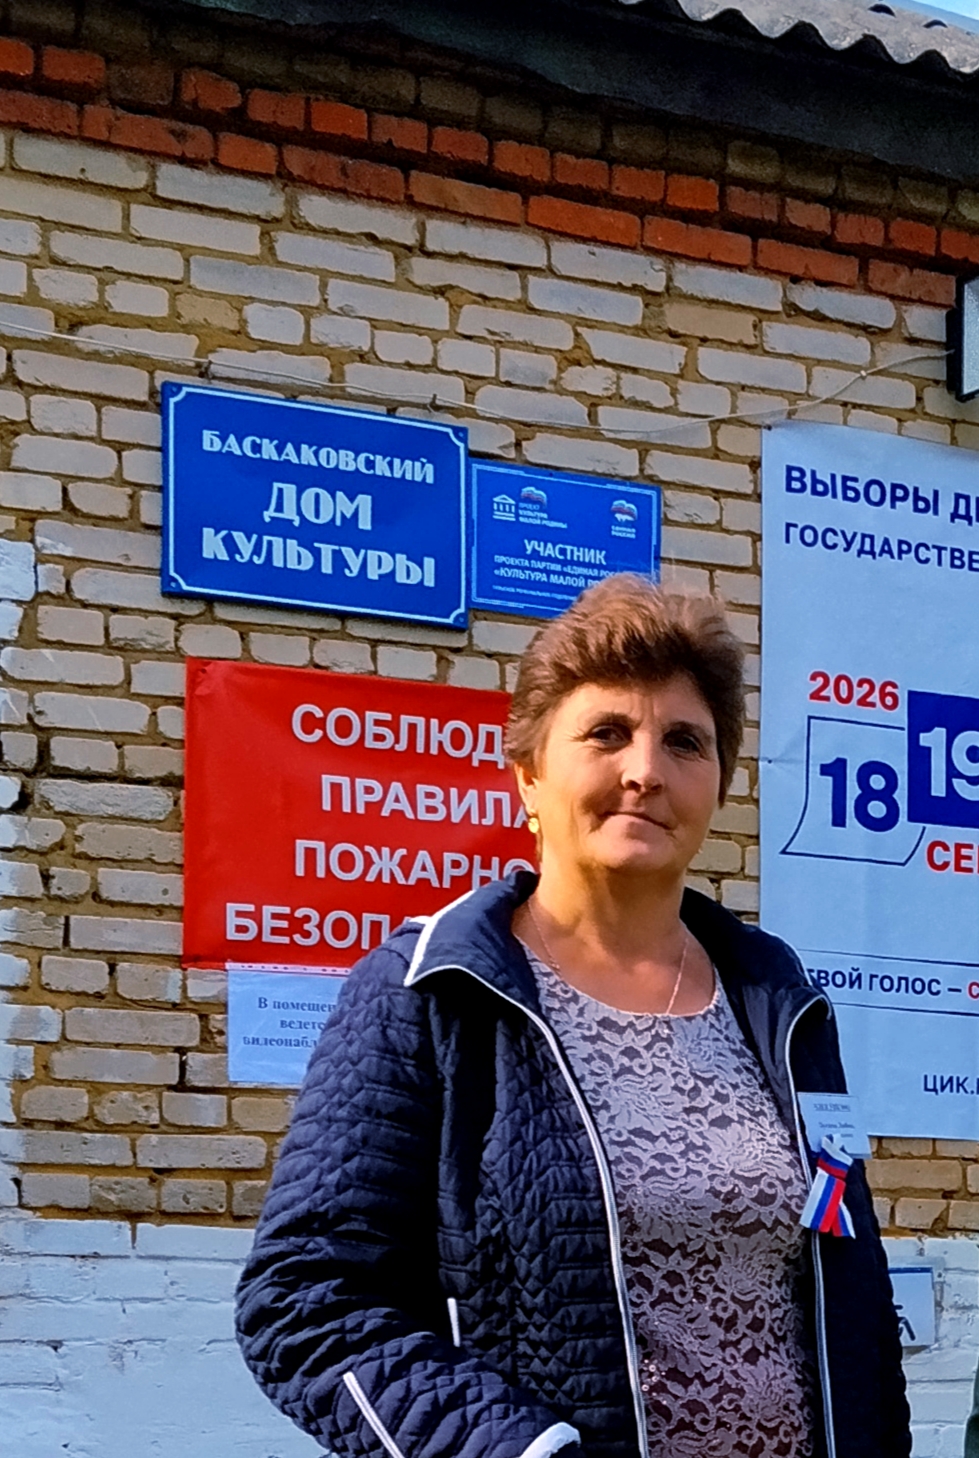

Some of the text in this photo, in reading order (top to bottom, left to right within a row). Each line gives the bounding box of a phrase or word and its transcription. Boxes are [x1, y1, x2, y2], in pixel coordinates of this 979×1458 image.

[202, 429, 434, 484] БАСКАКОВСКИЙ
[263, 481, 372, 530] ДОМ
[785, 464, 940, 516] ВЫБОРЫ
[202, 527, 435, 587] КУЛЬТУРЫ
[494, 555, 529, 567] ПРОЕКТА
[524, 539, 607, 565] УЧАСТНИК
[494, 567, 548, 582] «КУЛЬТУРА
[550, 573, 585, 588] МАЛОЙ
[808, 671, 900, 711] 2026
[291, 703, 505, 769] СОБЛЮД
[819, 756, 900, 832] 18
[226, 902, 411, 950] БЕЗОП
[258, 997, 268, 1009] В
[869, 973, 941, 996] ГОЛОС
